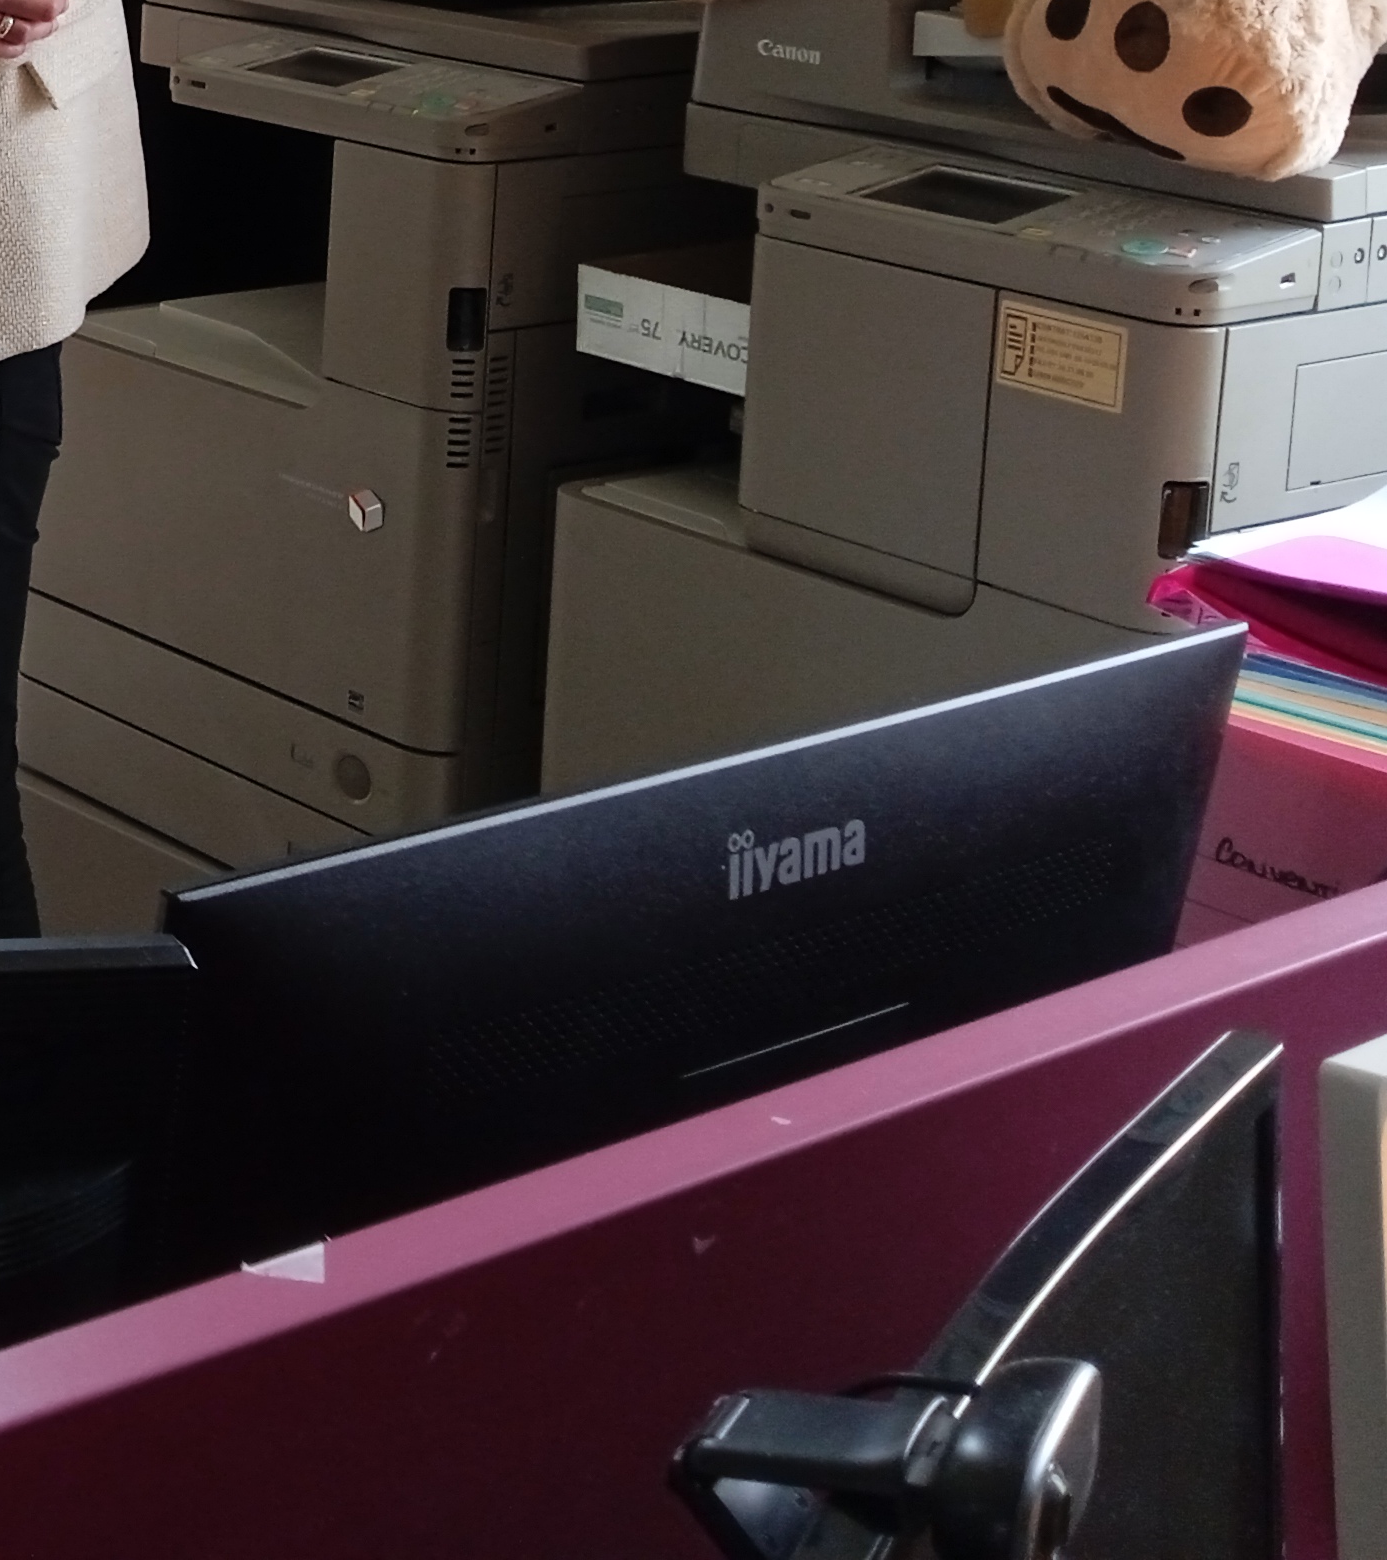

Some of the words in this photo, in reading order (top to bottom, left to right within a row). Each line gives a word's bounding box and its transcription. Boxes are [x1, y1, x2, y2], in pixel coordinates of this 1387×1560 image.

[757, 38, 821, 66] Canon
[641, 318, 661, 340] 75
[728, 818, 866, 901] iiyama
